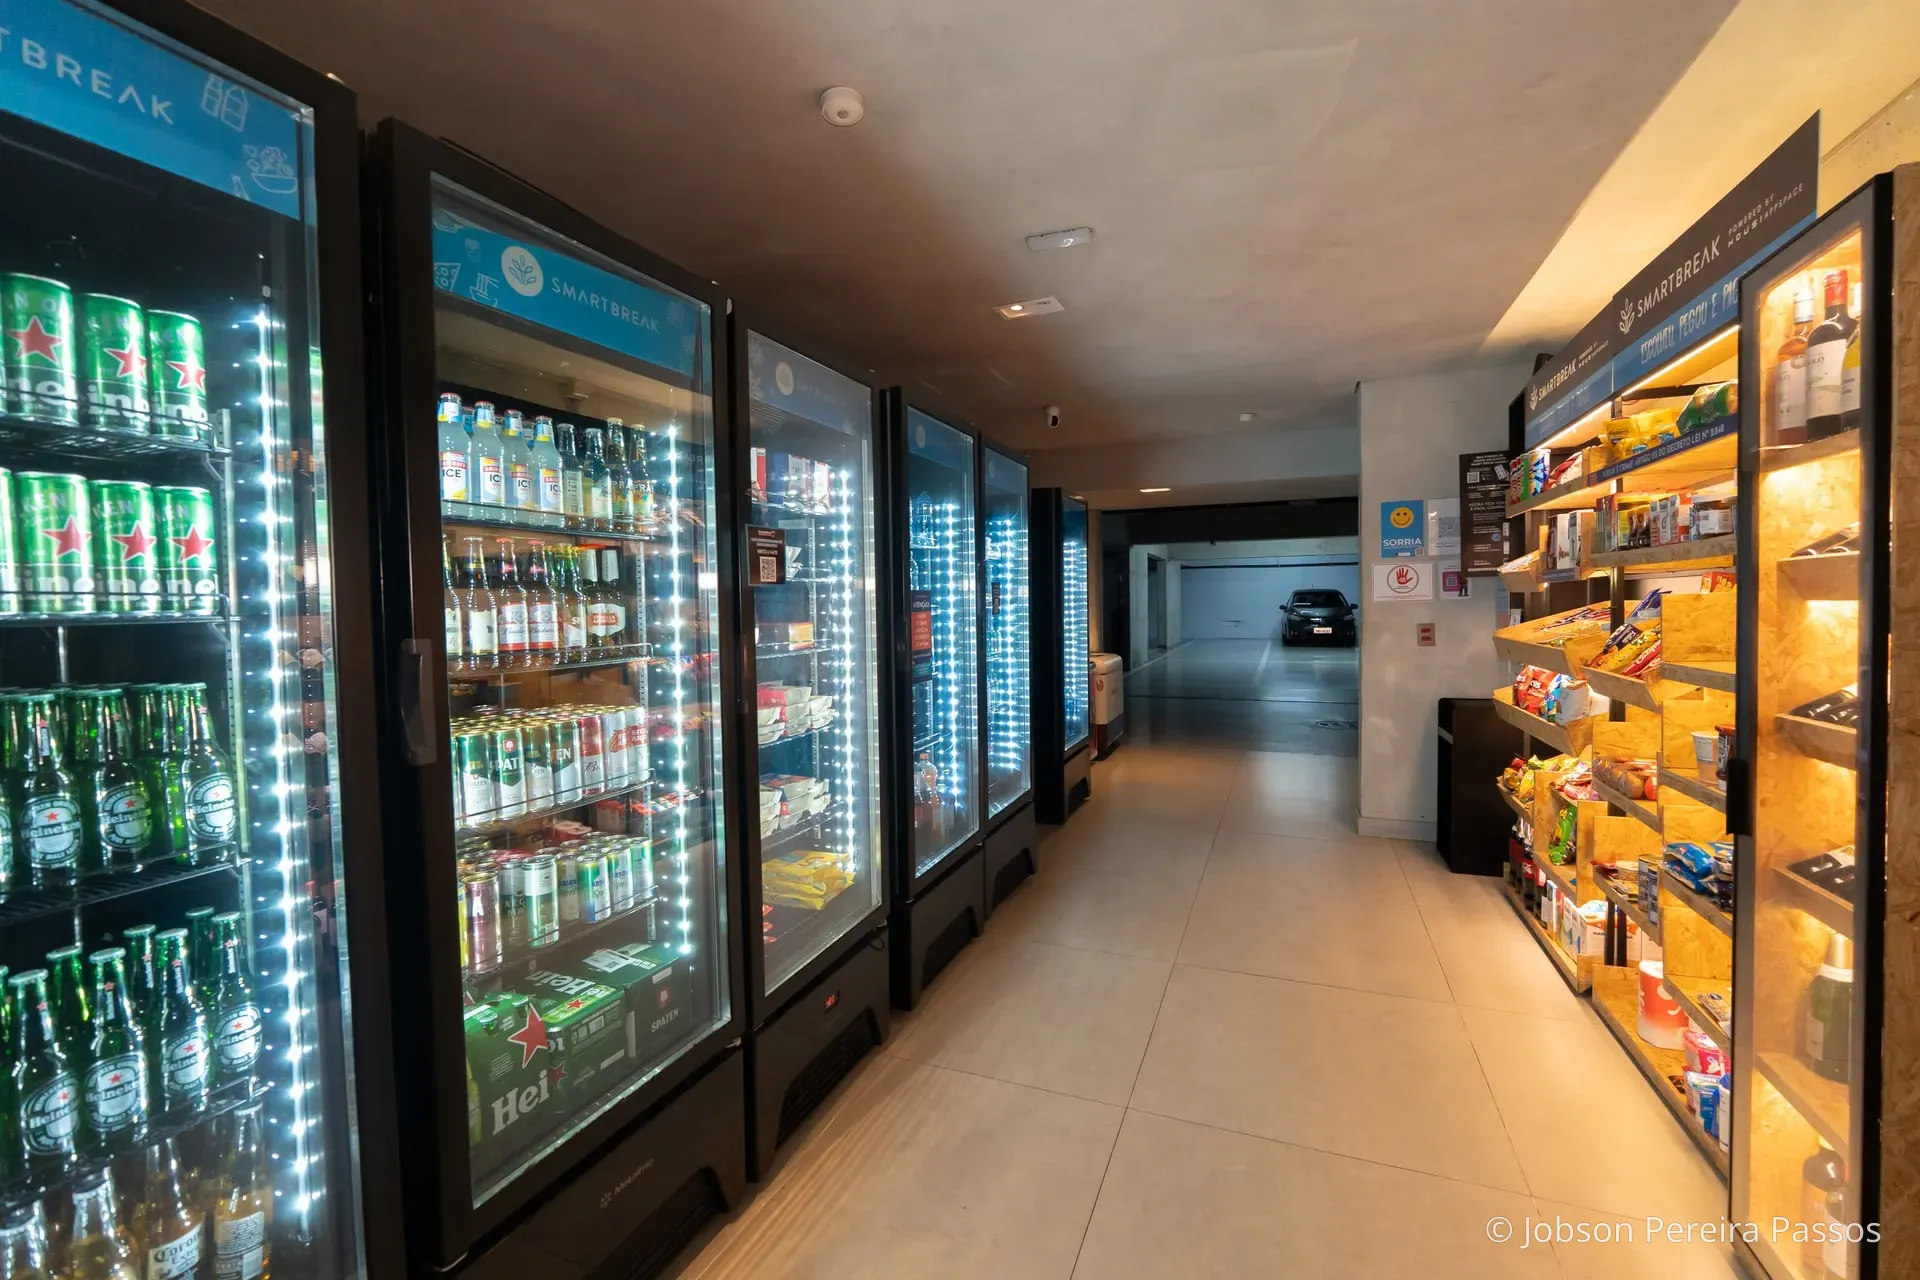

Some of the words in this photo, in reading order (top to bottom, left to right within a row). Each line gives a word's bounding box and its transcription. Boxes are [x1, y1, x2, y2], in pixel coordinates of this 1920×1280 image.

[1637, 235, 1721, 318] SMARTBREAK
[552, 276, 660, 333] SMARTBREAK
[1680, 300, 1708, 341] PEGOU
[1538, 358, 1577, 401] SMARTBREAK
[1383, 538, 1422, 552] SORRIA
[651, 1007, 679, 1033] SPATEN
